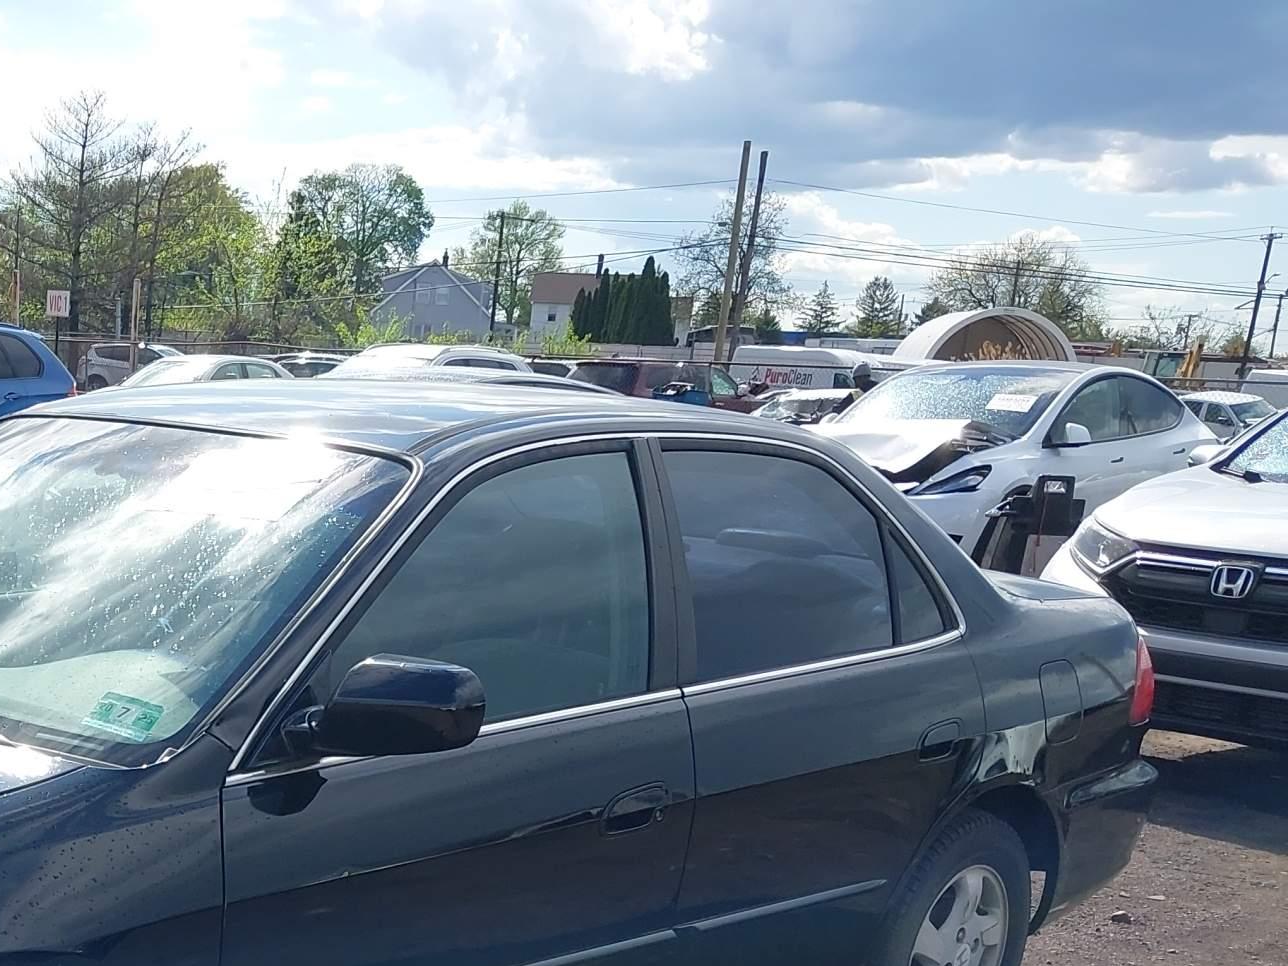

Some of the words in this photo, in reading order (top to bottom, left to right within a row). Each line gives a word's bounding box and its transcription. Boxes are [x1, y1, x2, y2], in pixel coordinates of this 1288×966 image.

[49, 295, 62, 313] VIC
[764, 368, 813, 385] PuroClean
[116, 706, 131, 718] 7
